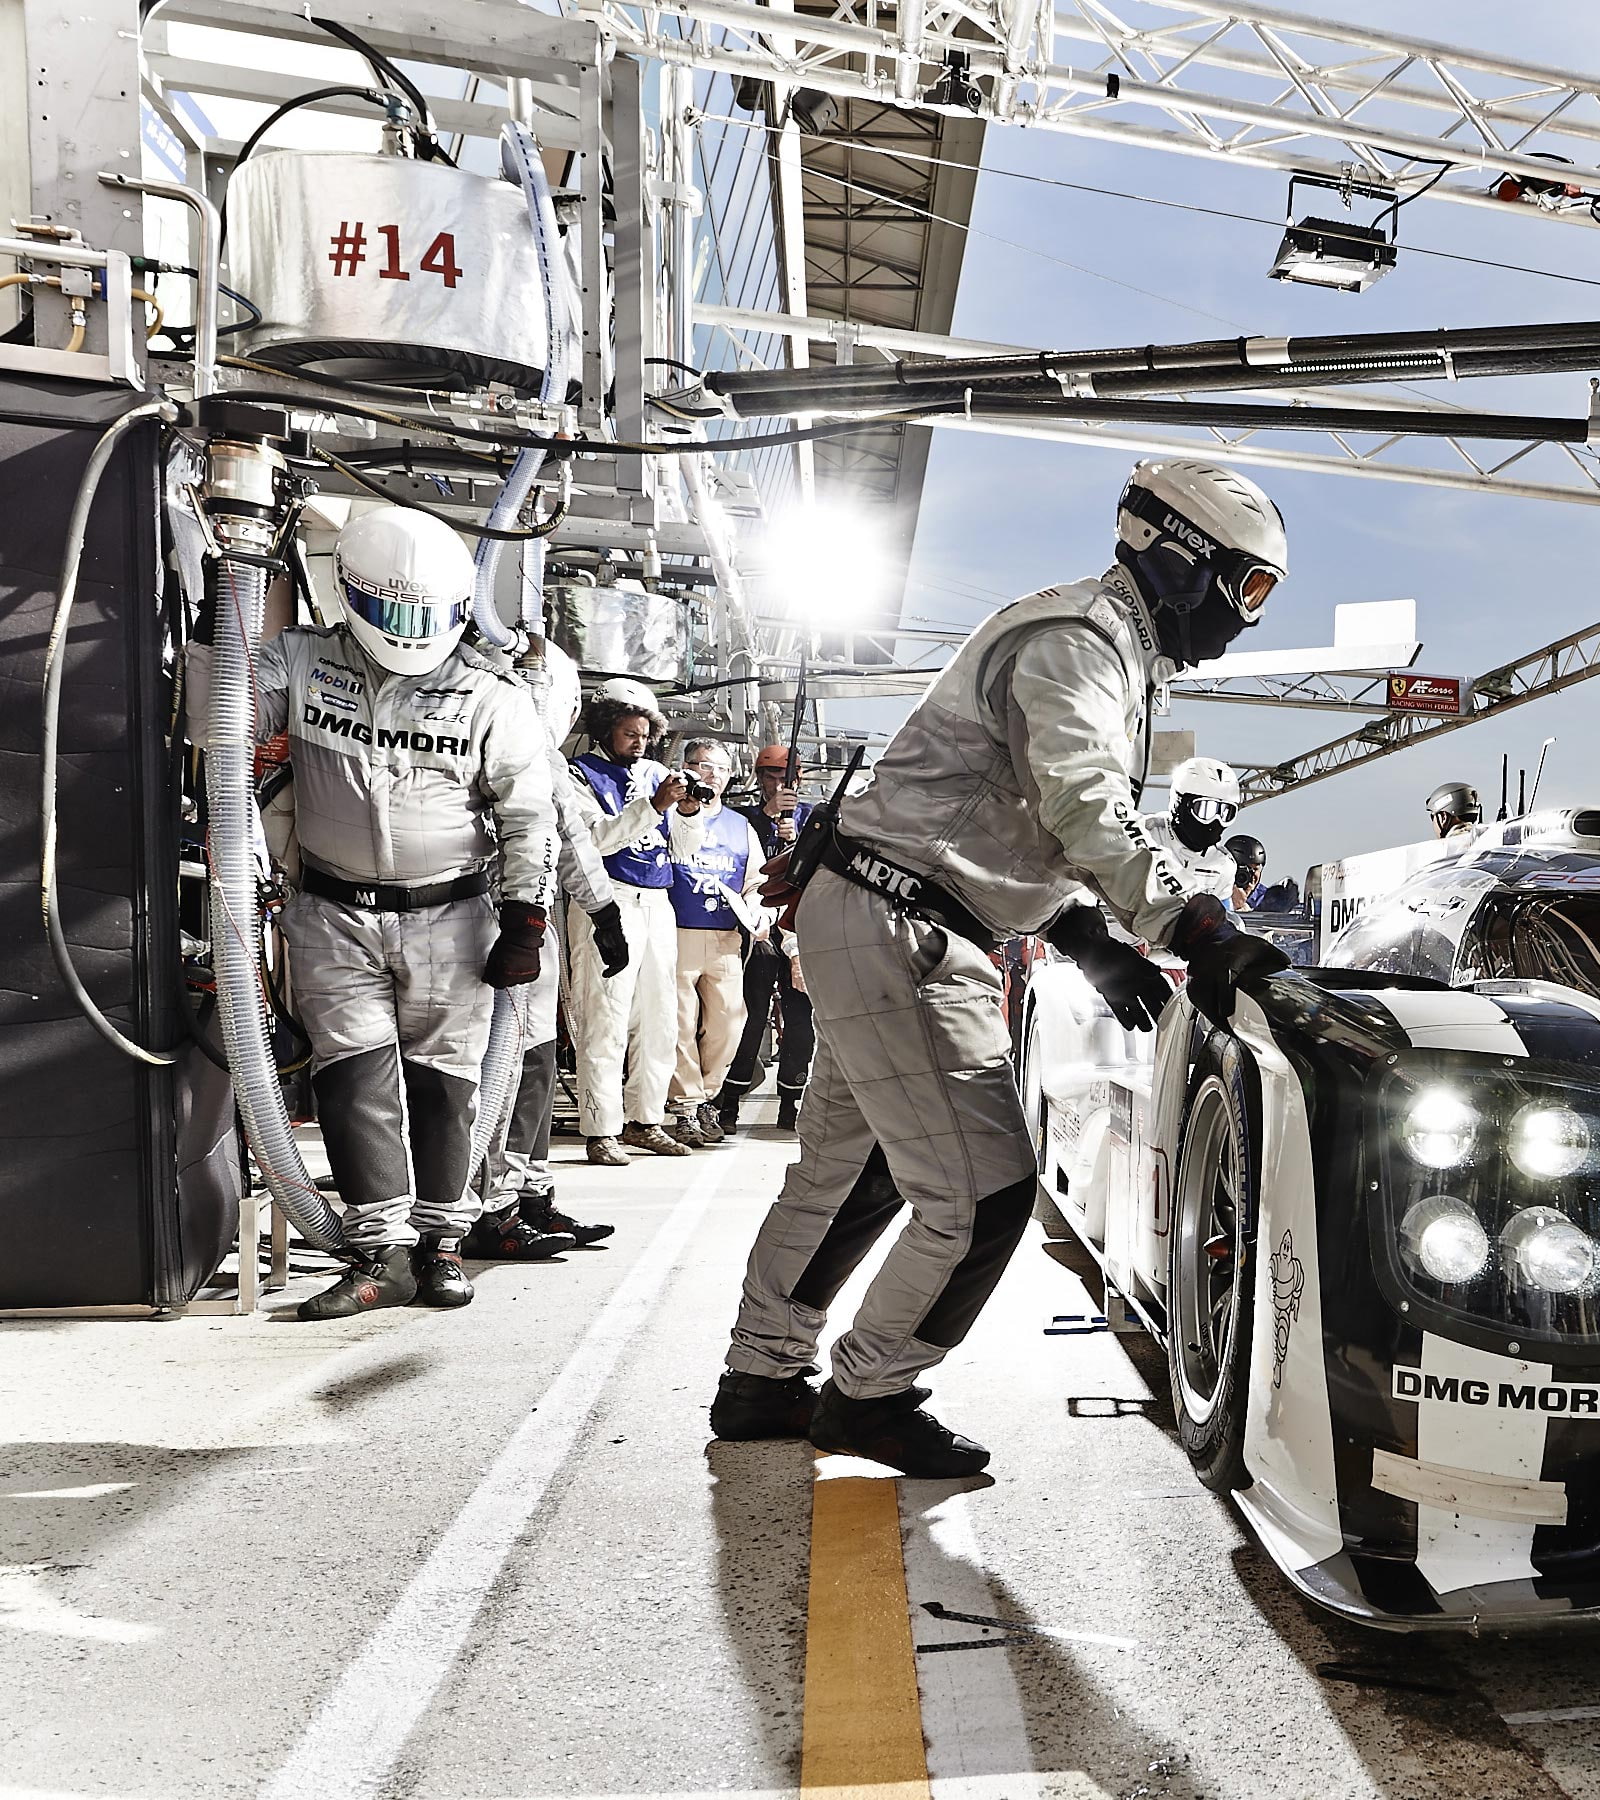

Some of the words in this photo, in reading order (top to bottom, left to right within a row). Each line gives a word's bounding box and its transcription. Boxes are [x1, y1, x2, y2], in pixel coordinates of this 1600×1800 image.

[329, 221, 462, 288] #14
[1162, 513, 1217, 559] uvex
[1113, 579, 1153, 651] CHOPARD
[1391, 700, 1415, 708] RACING
[1434, 703, 1459, 711] FERRARI
[303, 704, 372, 746] DMG
[377, 728, 469, 757] MORI
[1396, 1372, 1489, 1405] DMG
